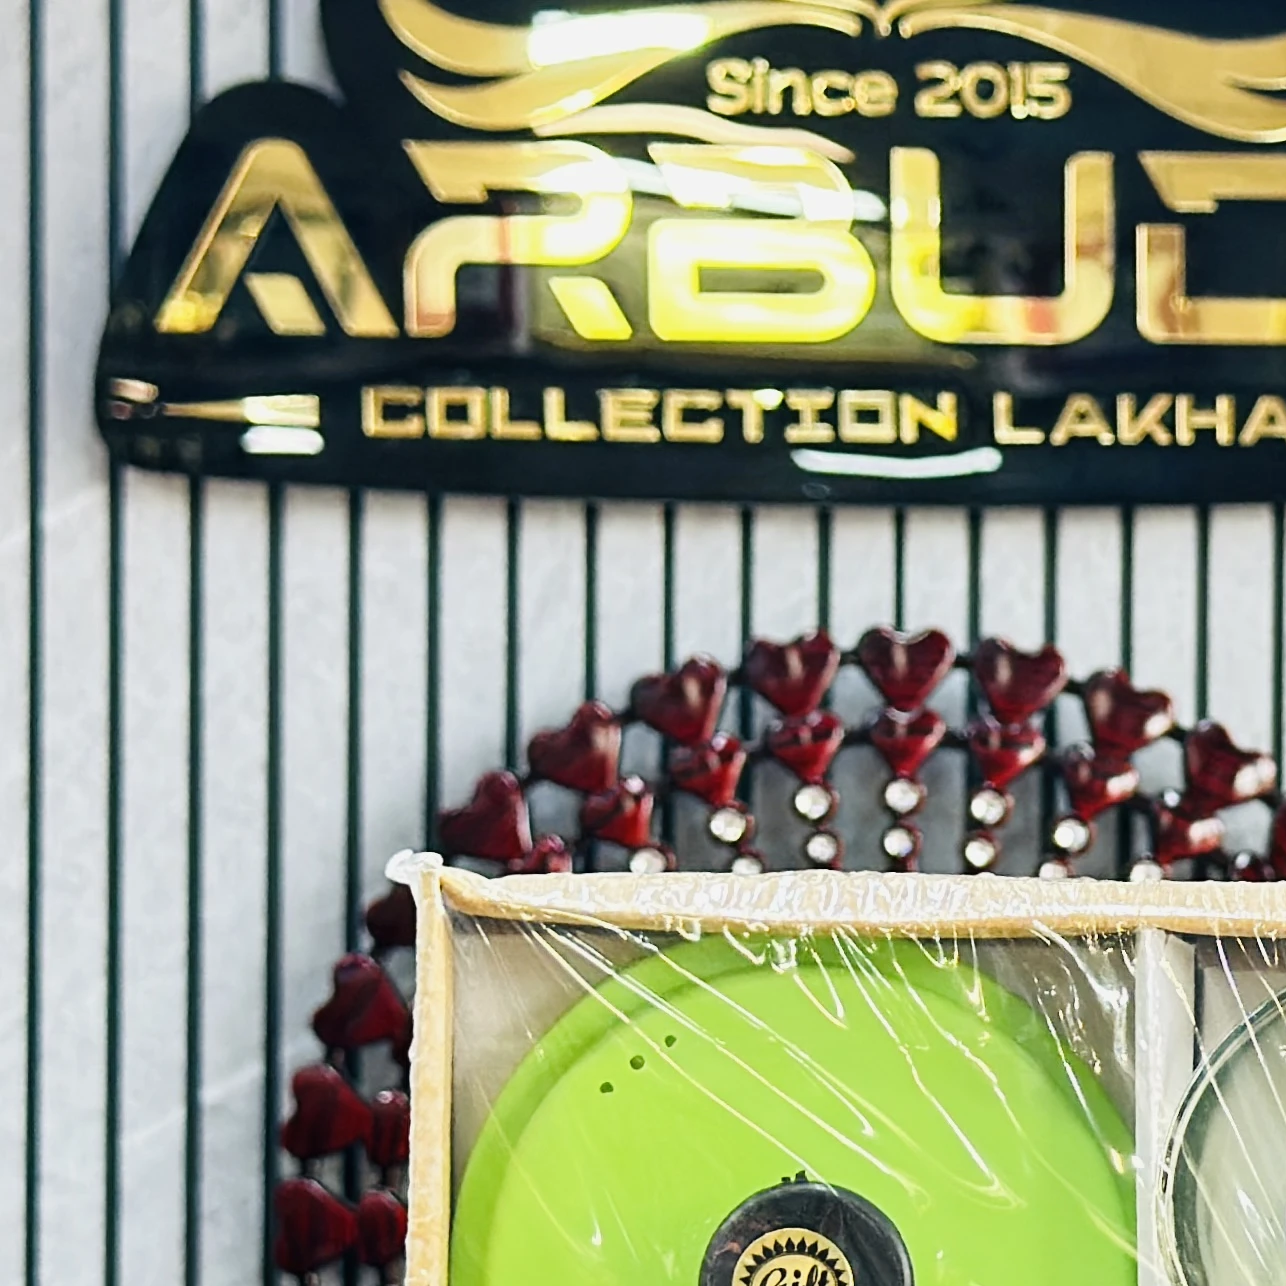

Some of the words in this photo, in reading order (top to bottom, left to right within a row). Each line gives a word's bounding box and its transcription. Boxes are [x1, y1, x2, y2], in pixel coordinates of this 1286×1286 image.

[705, 58, 897, 118] Since
[914, 60, 1072, 119] 2015
[361, 385, 958, 444] COLLECTION
